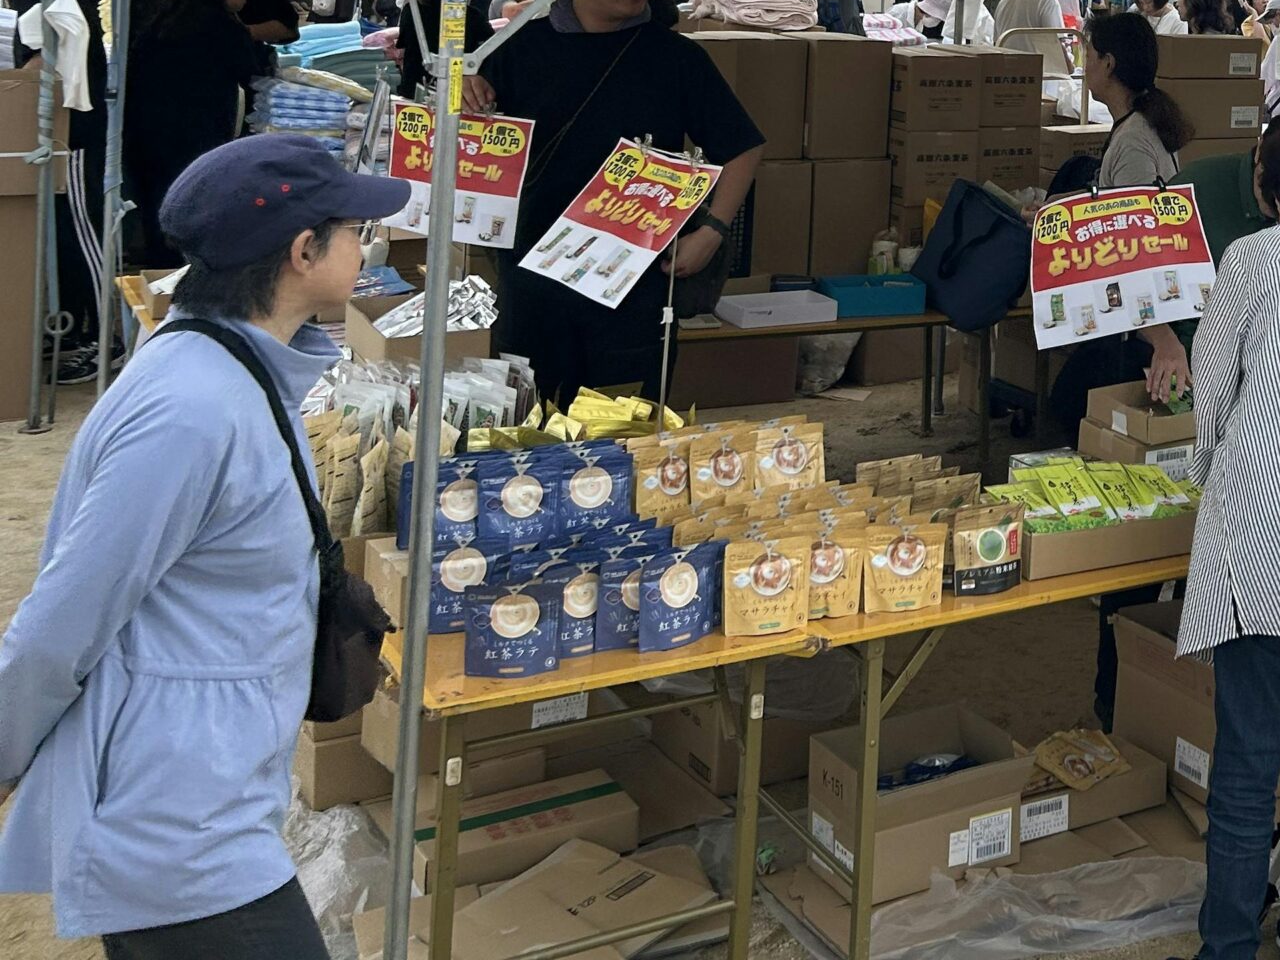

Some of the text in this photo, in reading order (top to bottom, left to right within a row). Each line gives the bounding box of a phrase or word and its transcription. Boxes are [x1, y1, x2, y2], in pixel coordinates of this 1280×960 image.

[1154, 196, 1180, 206] 4個で
[1153, 205, 1188, 216] 1500円
[1040, 211, 1061, 227] 3個で
[1075, 214, 1156, 242] お得に選べる
[658, 613, 701, 633] 紅茶ラテ
[484, 645, 539, 660] 紅茶ラテ
